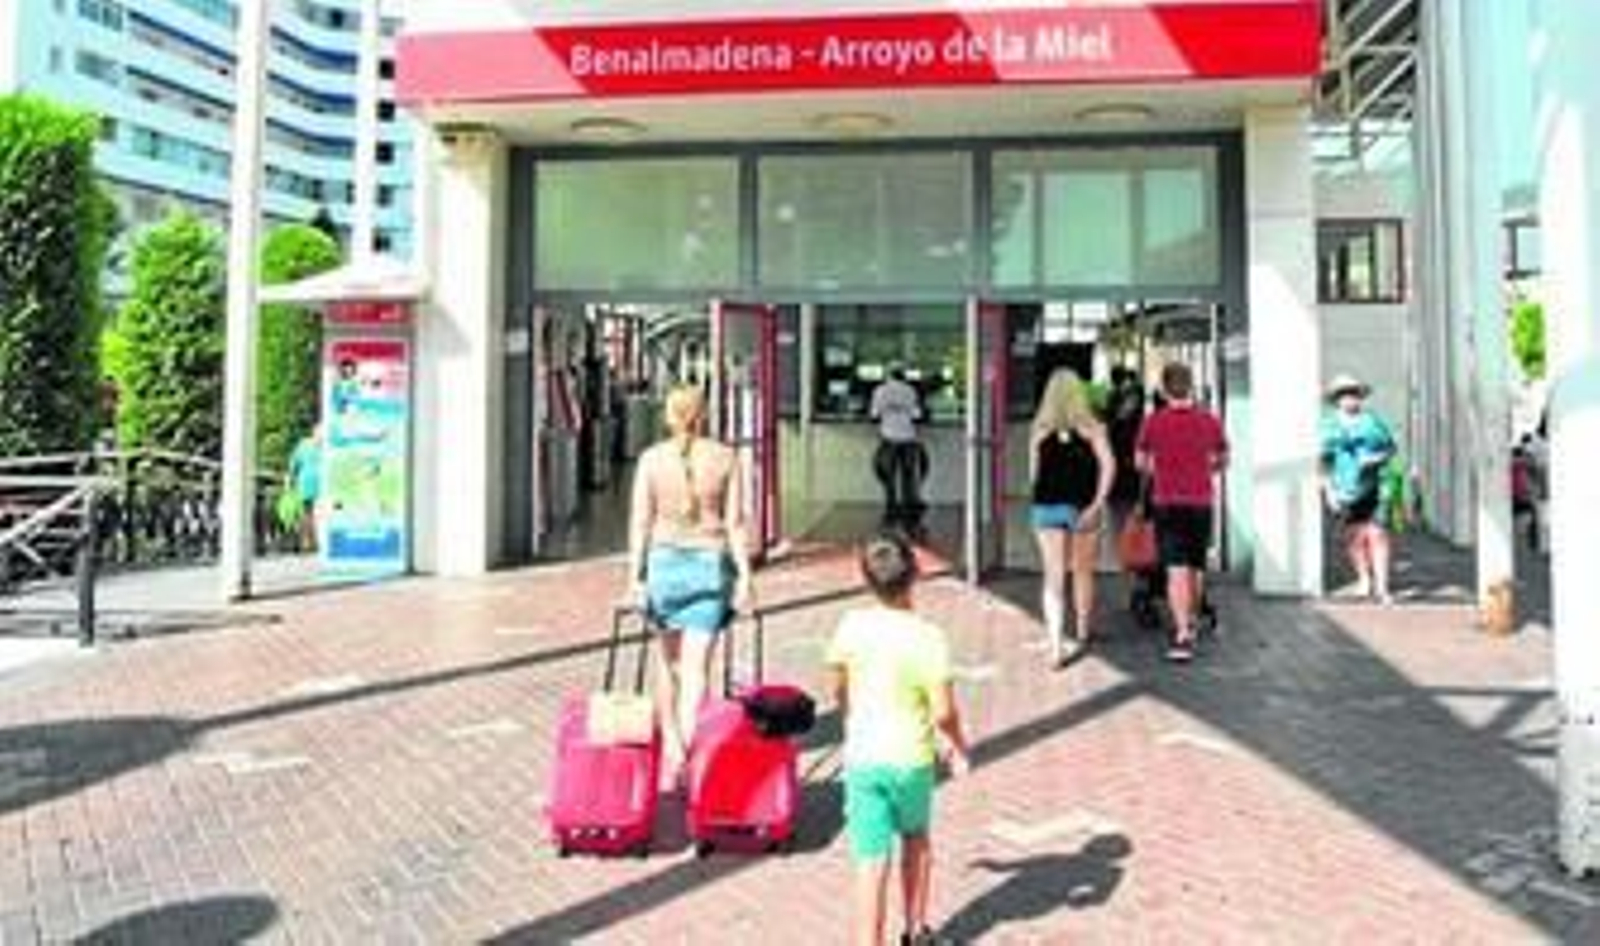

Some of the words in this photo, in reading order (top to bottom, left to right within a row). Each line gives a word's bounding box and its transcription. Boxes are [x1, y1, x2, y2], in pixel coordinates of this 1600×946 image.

[571, 38, 792, 76] Benalmadena
[822, 37, 932, 73] Arroyo
[944, 29, 986, 61] de
[994, 28, 1026, 61] la
[1034, 25, 1111, 60] Miel
